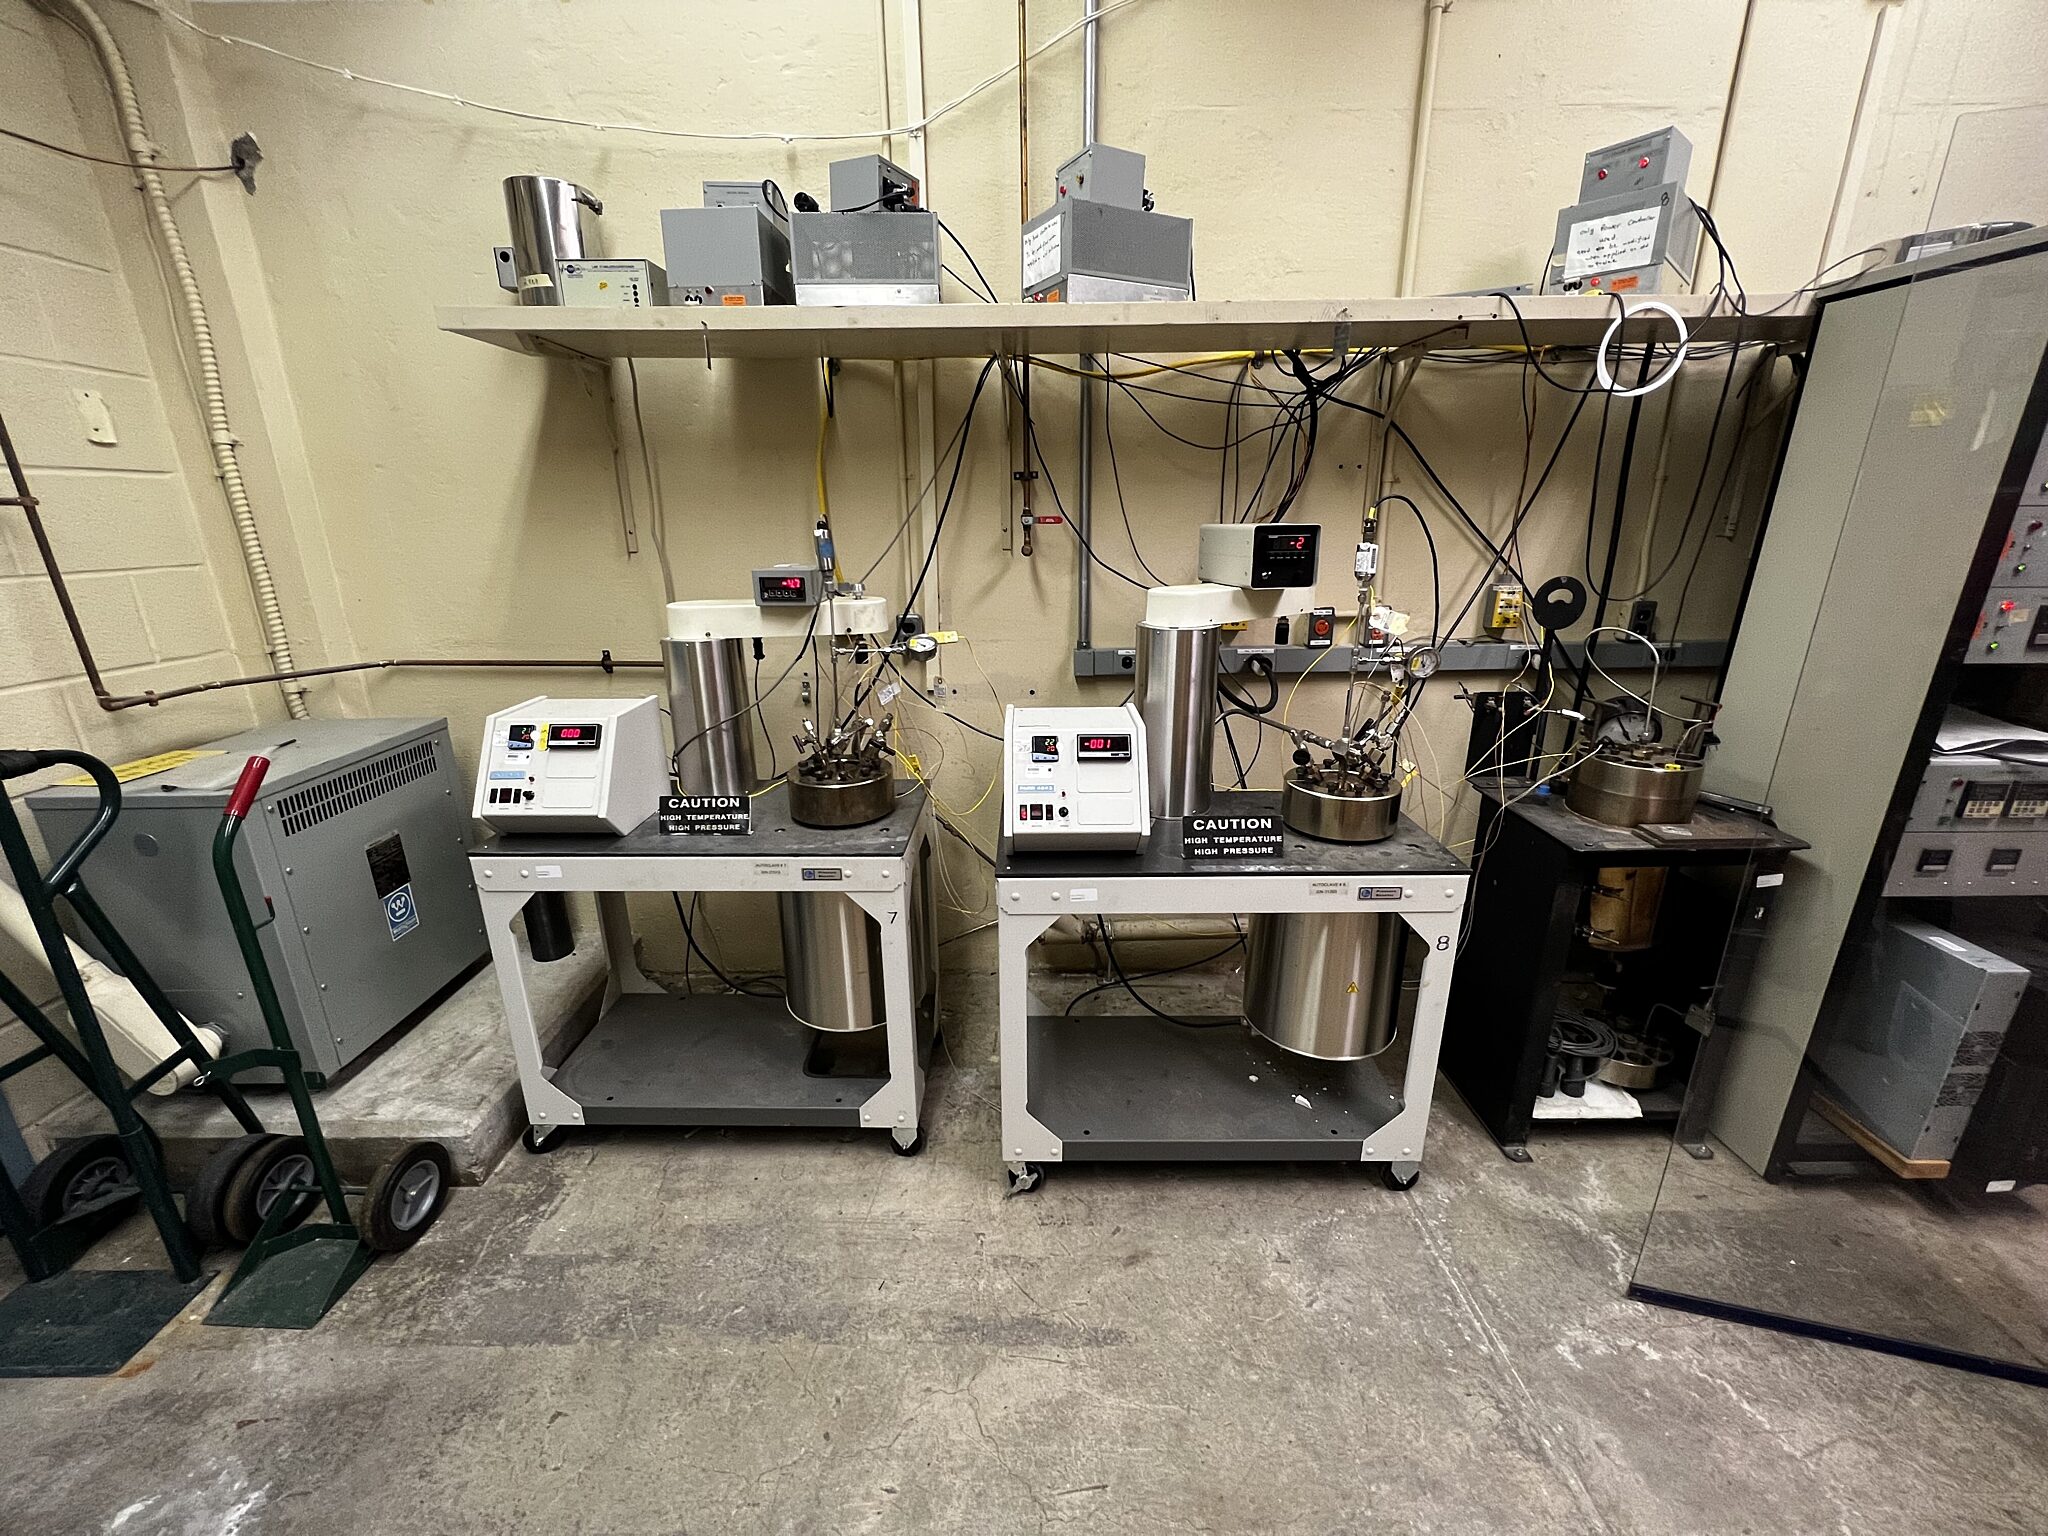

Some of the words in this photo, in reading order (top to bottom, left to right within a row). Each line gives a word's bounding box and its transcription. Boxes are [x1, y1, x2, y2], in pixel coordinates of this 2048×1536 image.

[1661, 192, 1669, 206] 8
[668, 798, 740, 809] CAUTION
[686, 813, 749, 821] TEMPERATURE
[1193, 818, 1272, 831] CAUTION
[1213, 835, 1283, 844] TEMPERATURE
[1223, 847, 1274, 855] PRESSURE
[887, 911, 898, 924] 7
[1436, 935, 1450, 951] 8
